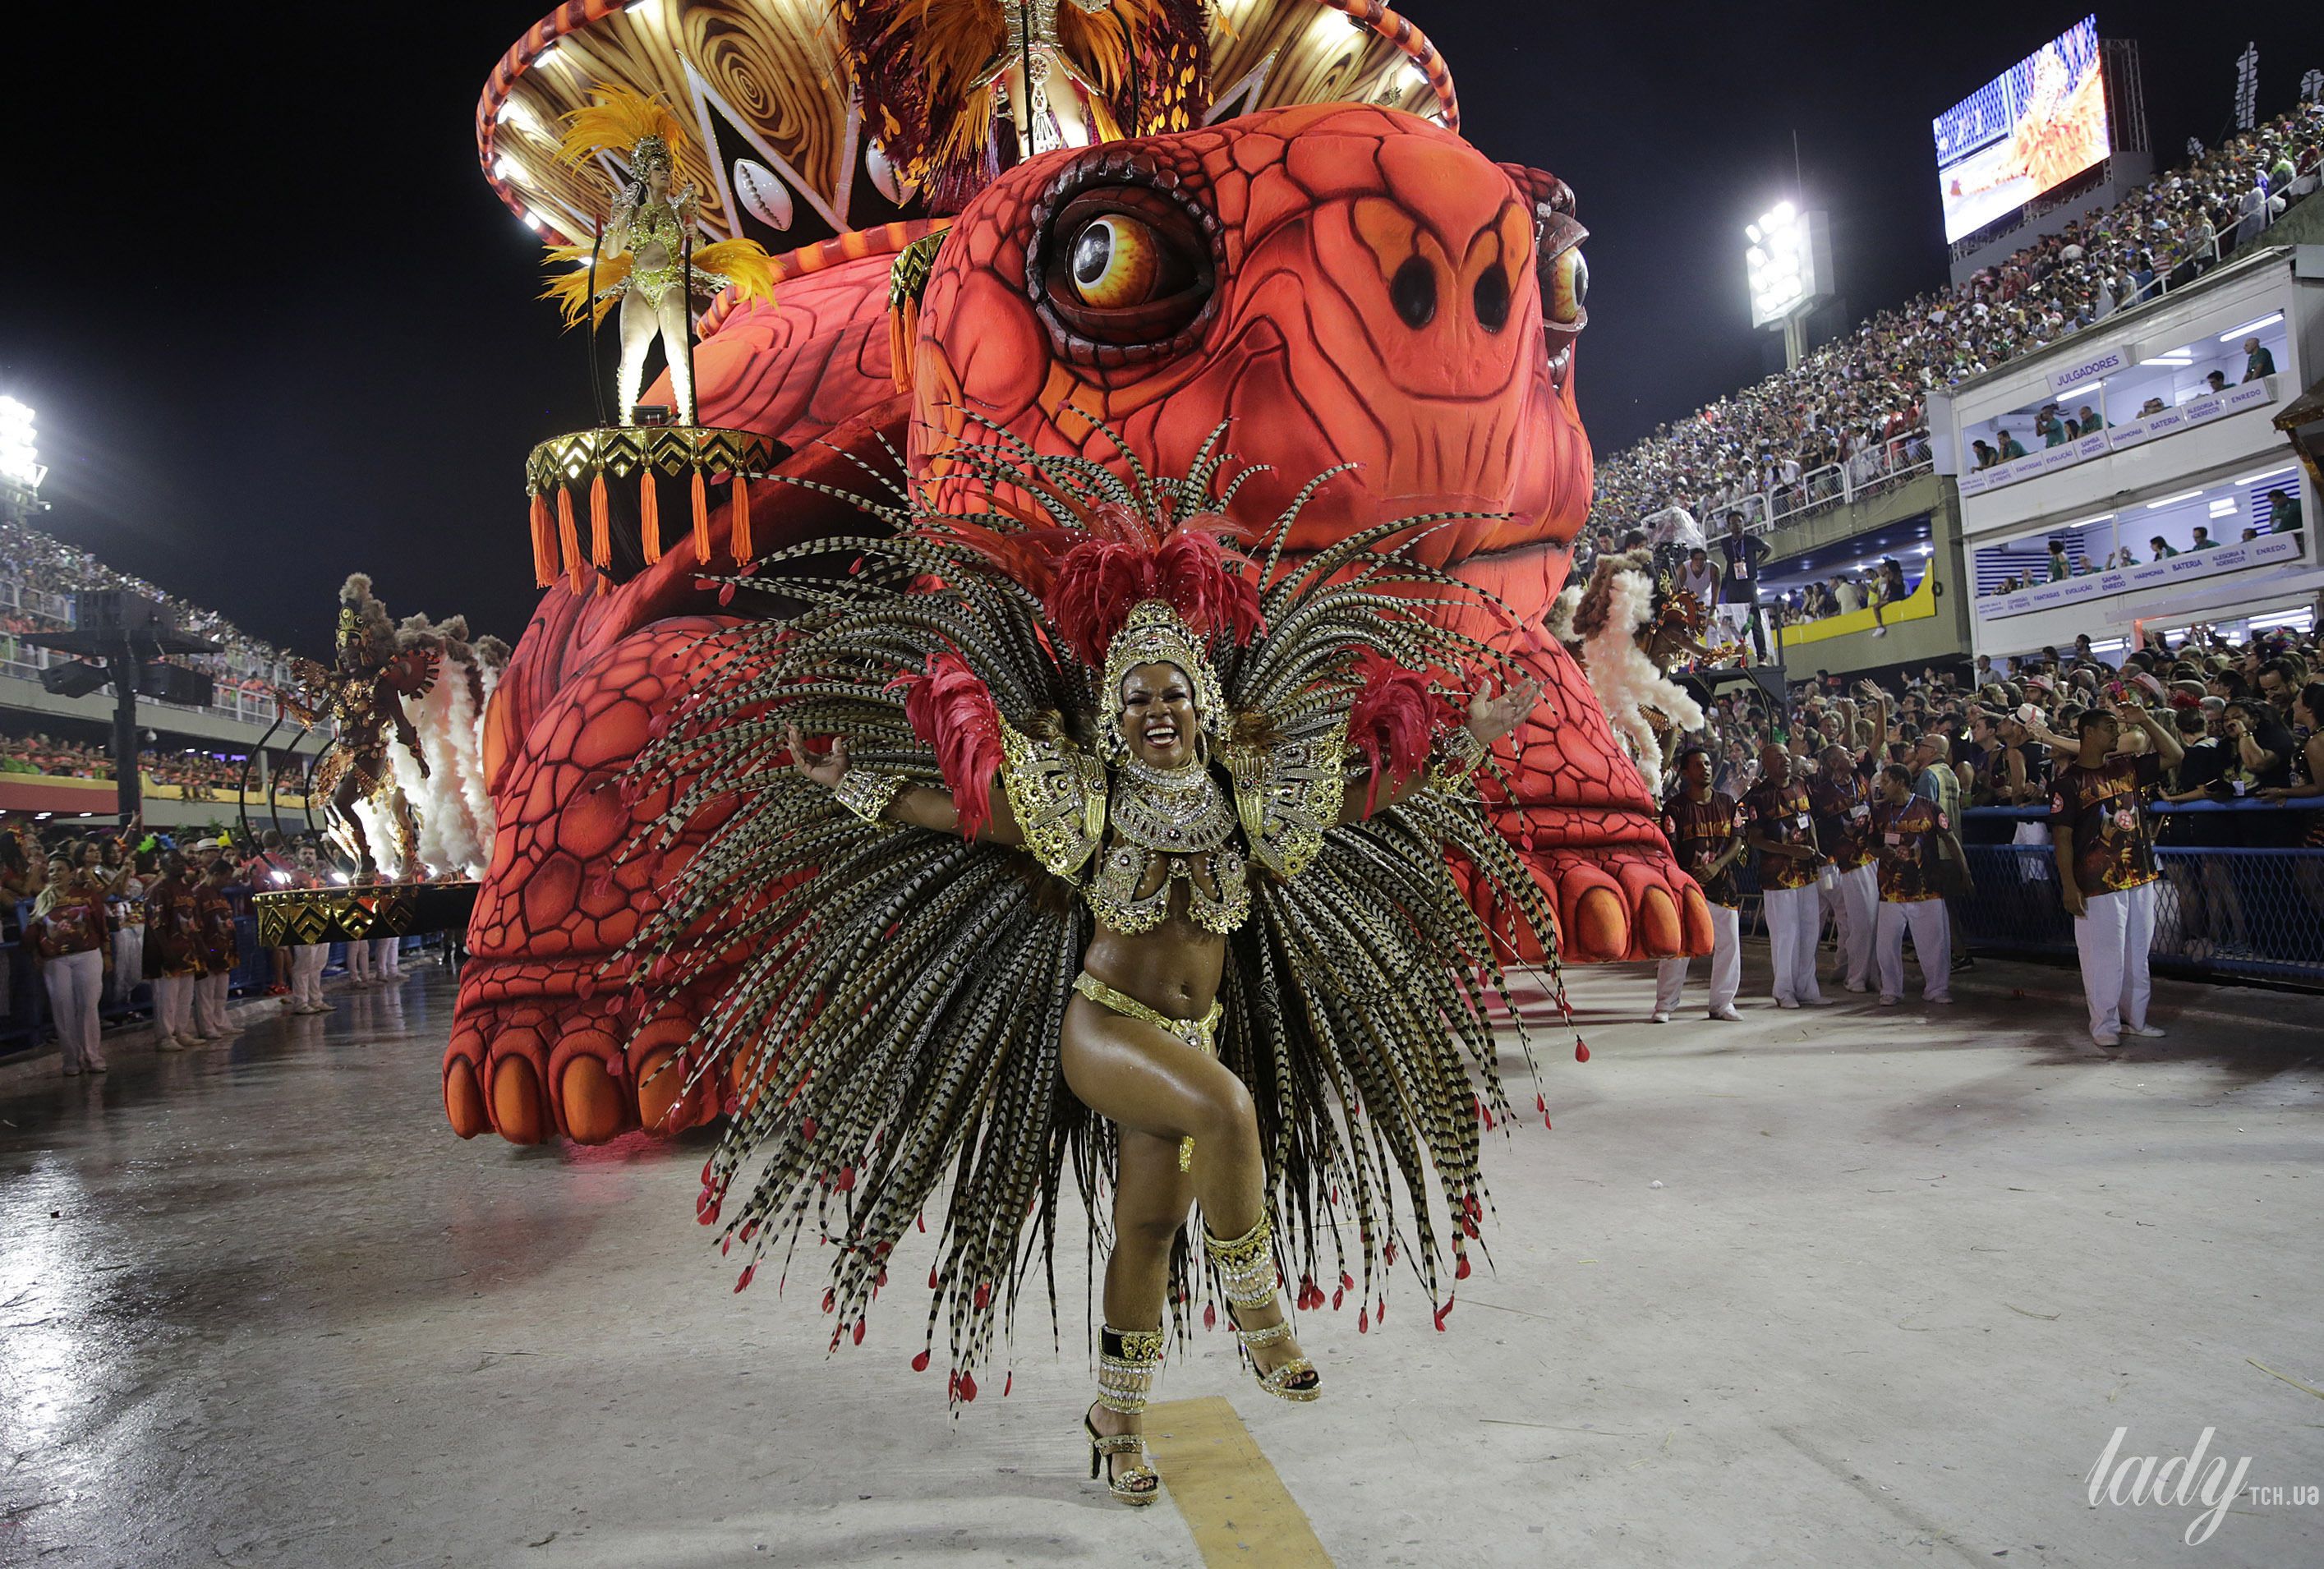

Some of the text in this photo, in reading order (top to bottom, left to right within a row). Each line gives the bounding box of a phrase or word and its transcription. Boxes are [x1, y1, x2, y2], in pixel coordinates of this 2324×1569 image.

[2057, 355, 2119, 386] JULGADORES
[2231, 389, 2261, 404] ENREDO
[2187, 400, 2214, 414] ALEGORIA
[2151, 416, 2180, 430] BATERIA
[2113, 428, 2142, 442] HARMONIA
[2081, 436, 2100, 448] SAMBA
[2082, 443, 2105, 455] ENREDO
[2046, 449, 2073, 464] EVOLUÇÃO
[2016, 461, 2042, 473] FANTASIAS
[2256, 544, 2286, 555] ENREDO
[2212, 550, 2239, 562] ALEGORIA
[2172, 559, 2202, 572] BATERIA
[2101, 574, 2122, 584] SAMBA
[2134, 568, 2165, 580] HARMONIA
[2065, 584, 2093, 596] EVOLUÇÃO
[2102, 580, 2126, 591] ENREDO
[2034, 591, 2060, 601] FANTASIAS
